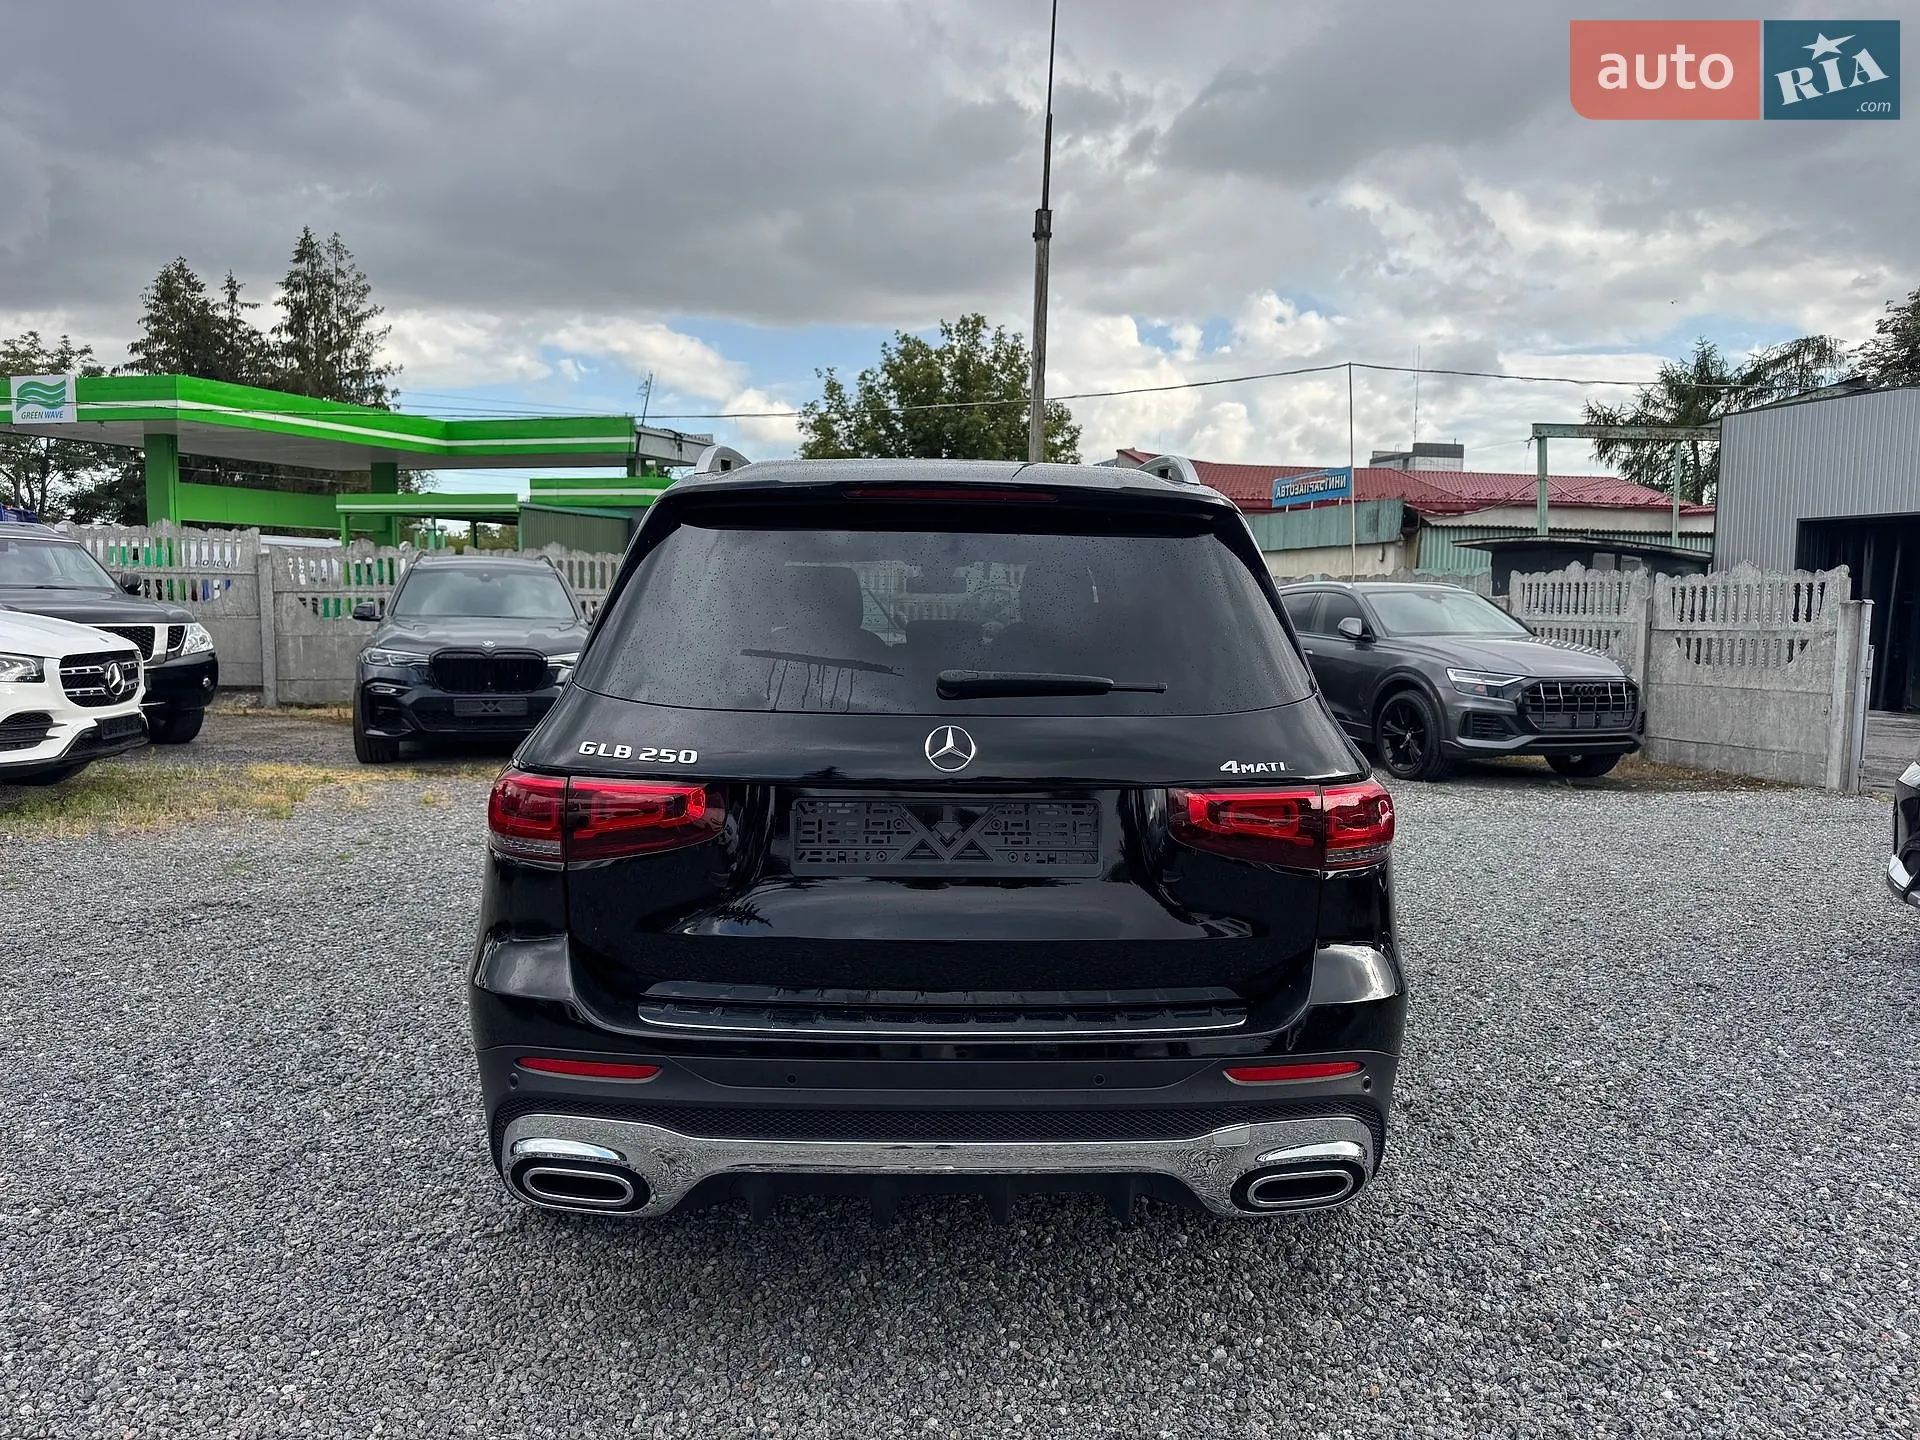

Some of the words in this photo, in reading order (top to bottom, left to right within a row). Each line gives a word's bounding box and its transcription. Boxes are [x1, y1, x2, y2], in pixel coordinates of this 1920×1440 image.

[21, 411, 44, 420] GREEN
[44, 410, 64, 419] WAVE
[578, 741, 633, 759] GLB
[638, 747, 698, 764] 250
